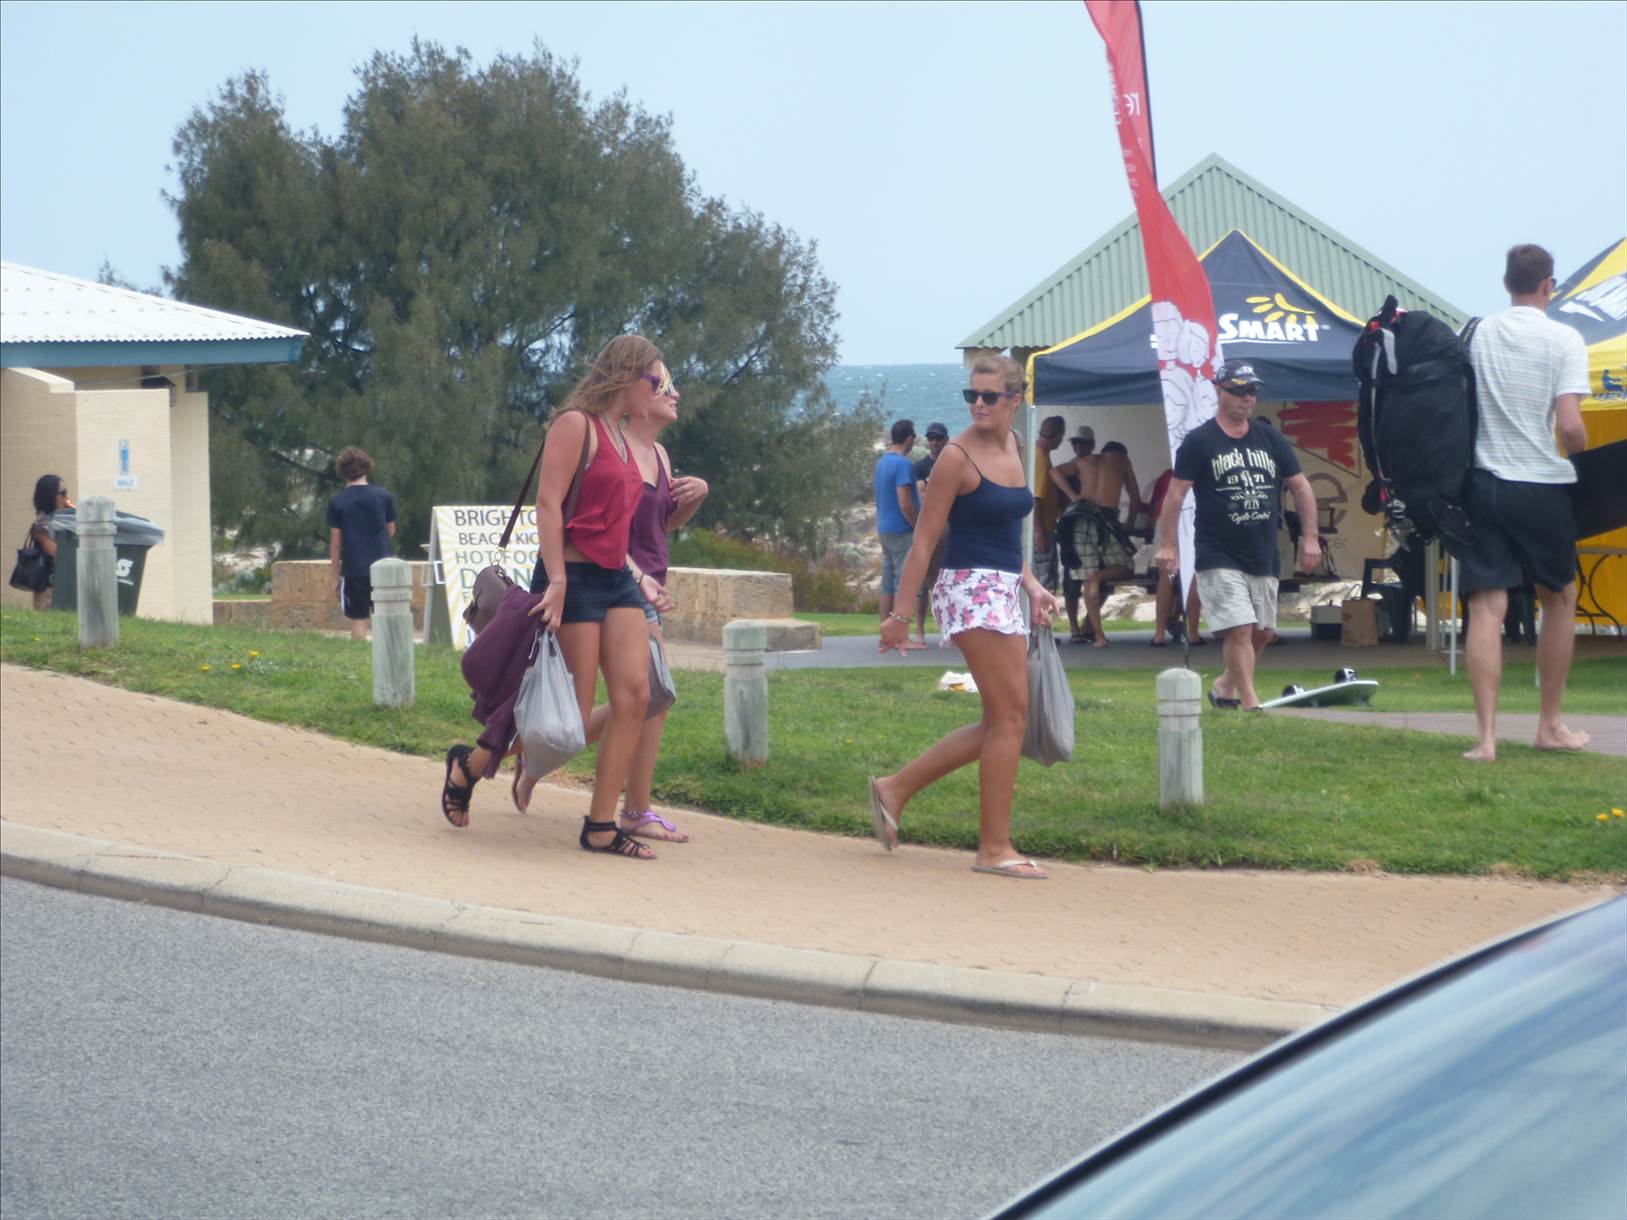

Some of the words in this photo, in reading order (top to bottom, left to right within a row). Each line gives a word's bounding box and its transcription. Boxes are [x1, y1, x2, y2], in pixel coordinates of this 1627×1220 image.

[1218, 313, 1319, 342] SMART
[1212, 448, 1245, 481] black
[1246, 448, 1276, 479] hills
[1227, 474, 1239, 484] 19
[1253, 473, 1265, 483] 71
[458, 532, 511, 546] BEAC
[456, 550, 494, 565] HOT
